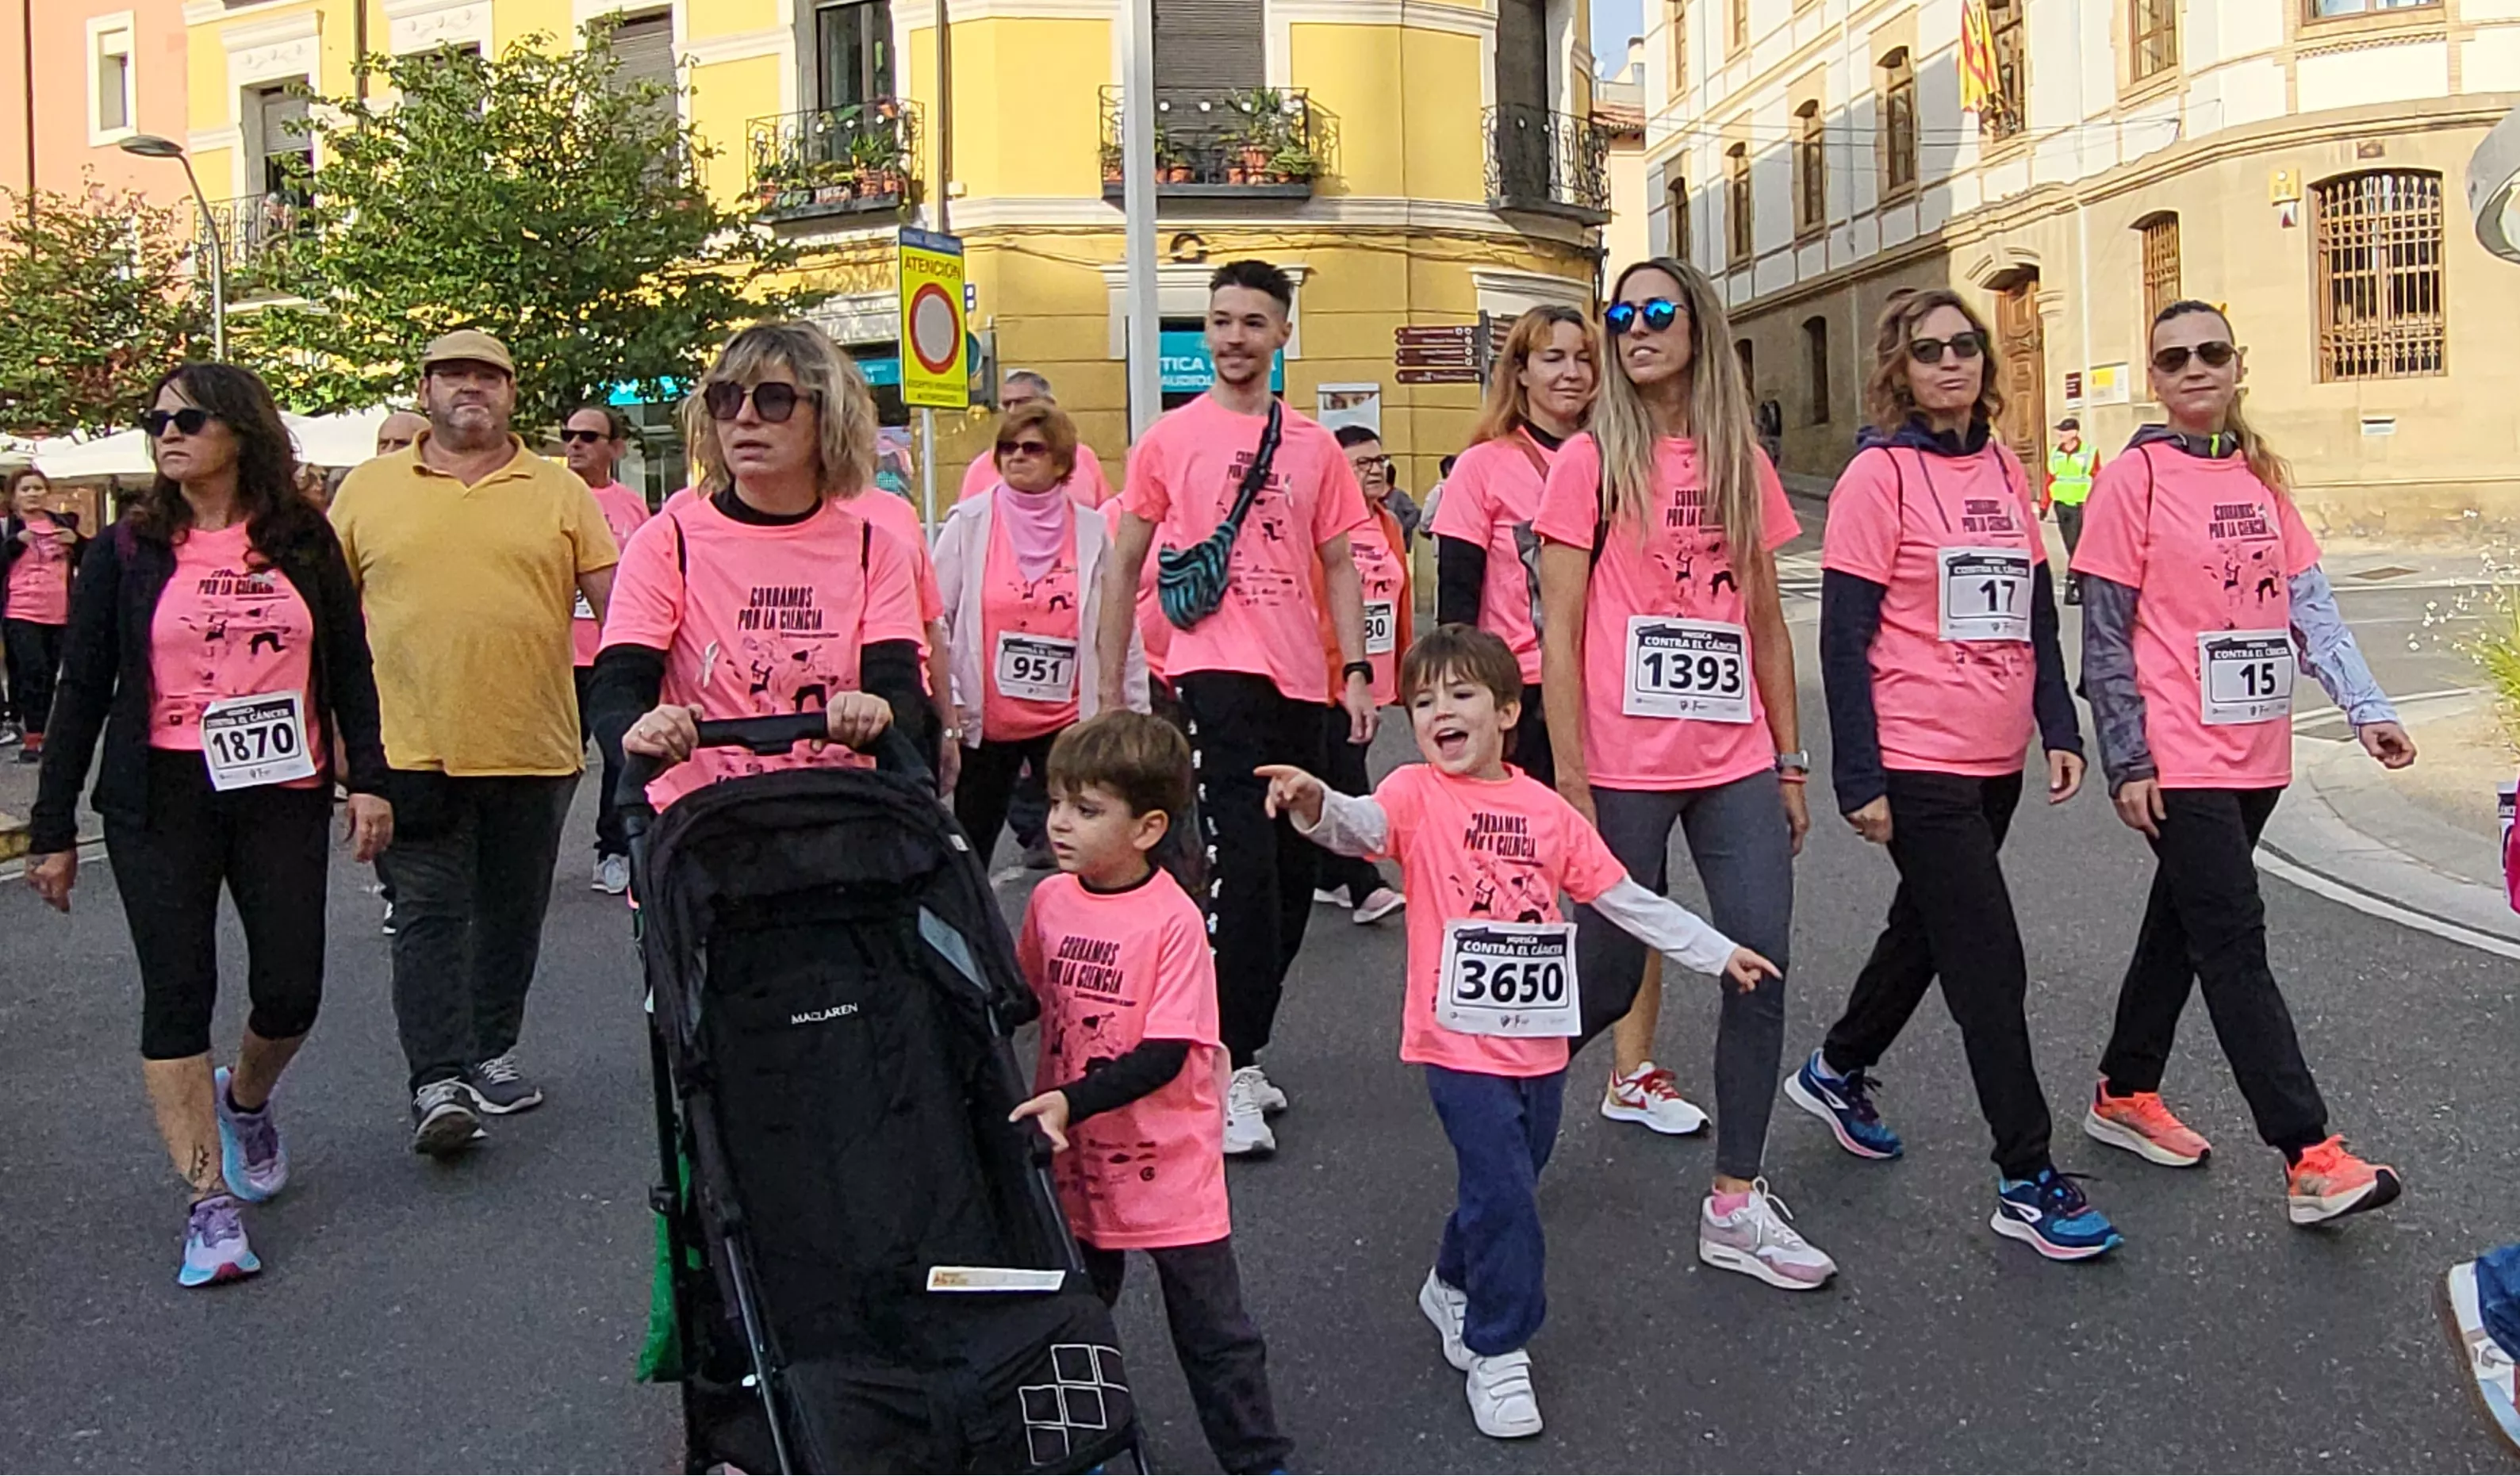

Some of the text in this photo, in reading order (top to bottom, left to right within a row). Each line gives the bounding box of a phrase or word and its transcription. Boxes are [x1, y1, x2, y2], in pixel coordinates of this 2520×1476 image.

[1160, 357, 1205, 371] TICA
[1161, 374, 1215, 386] AUDIOL
[1666, 508, 1684, 527] POR
[749, 586, 813, 608] CORRAMOS
[1979, 580, 2016, 613] 17
[737, 608, 823, 632] POR LA CIENCIA
[1644, 636, 1690, 648] CONTRA
[1692, 639, 1704, 650] EL
[2215, 650, 2253, 659] CONTRA
[1012, 656, 1061, 683] 951
[1643, 652, 1740, 693] 1393
[2239, 662, 2276, 696] 15
[213, 723, 294, 763] 1870
[1057, 935, 1121, 967] CORRAMOS
[1463, 940, 1515, 956] CONTRA
[1517, 945, 1529, 956] EL
[1076, 964, 1123, 994] CIENCIA
[1456, 960, 1564, 1003] 3650
[791, 1003, 858, 1025] MACLAREN
